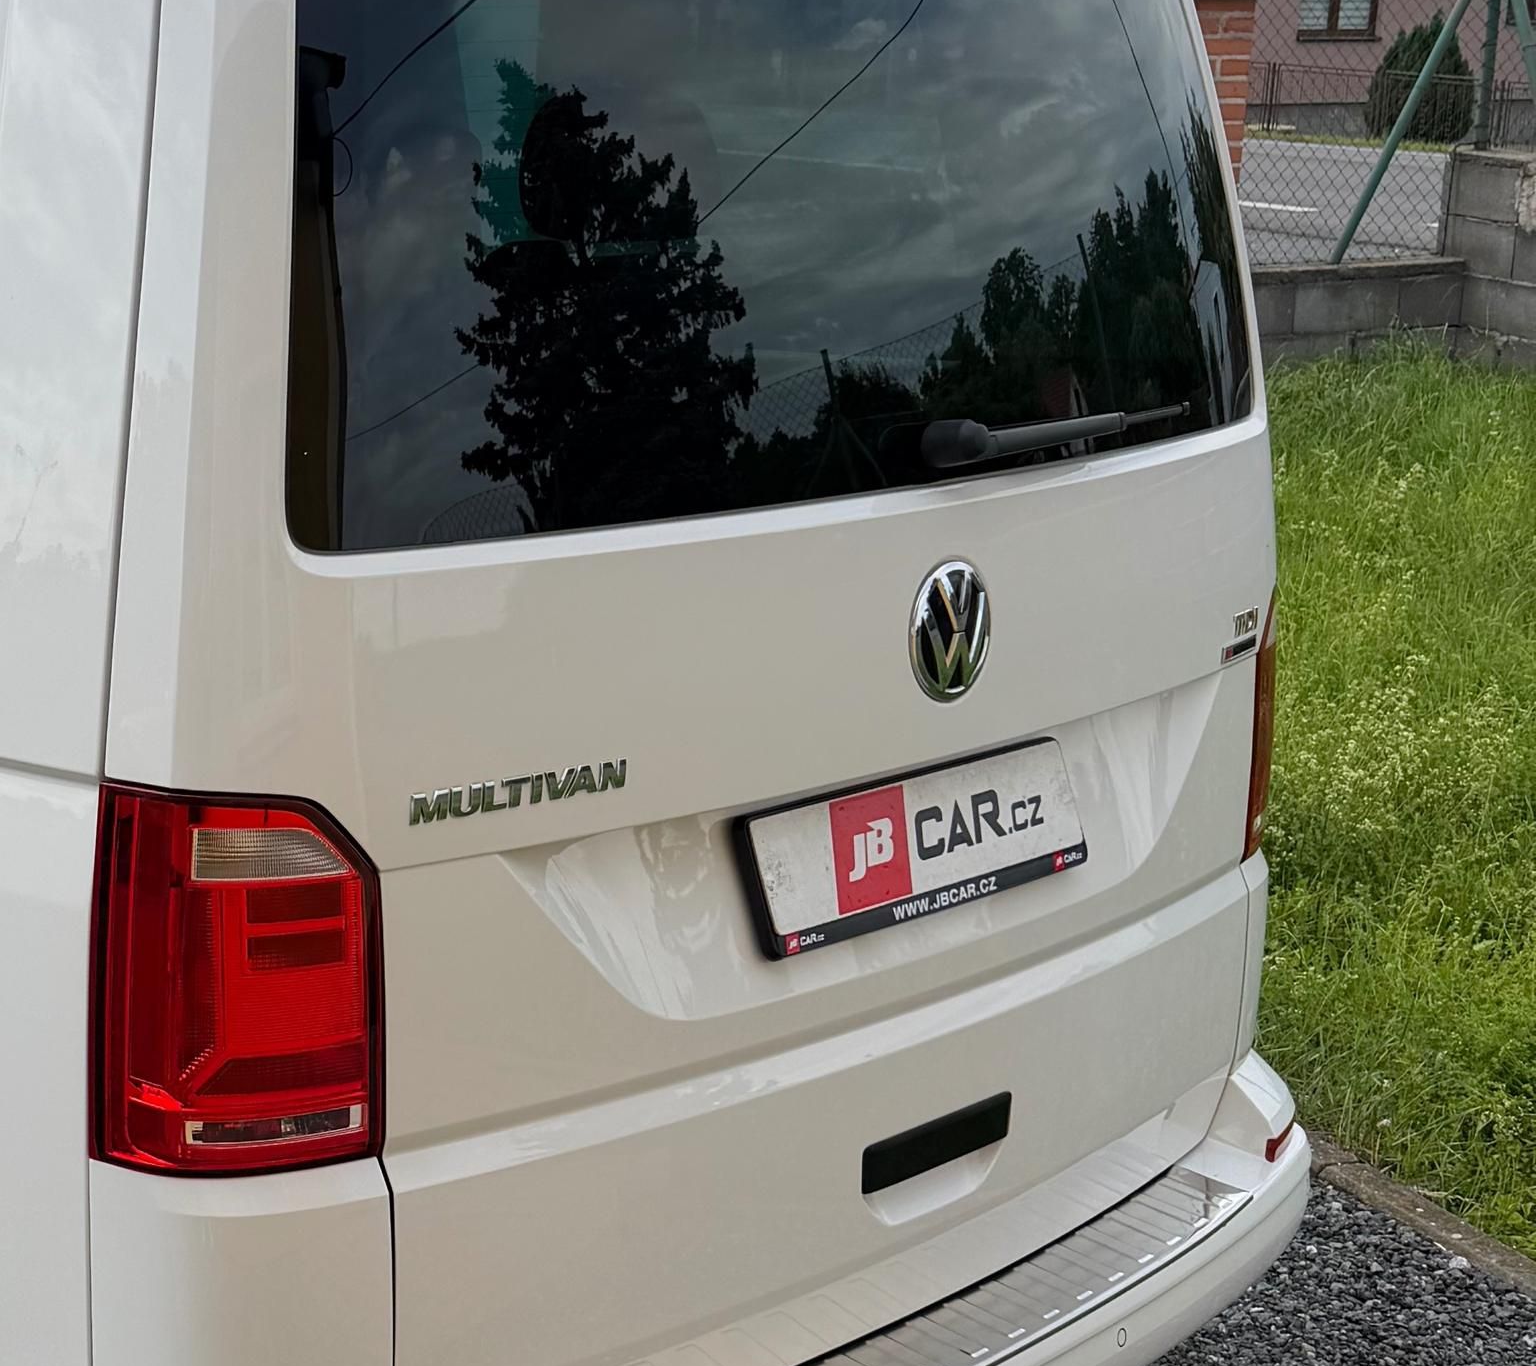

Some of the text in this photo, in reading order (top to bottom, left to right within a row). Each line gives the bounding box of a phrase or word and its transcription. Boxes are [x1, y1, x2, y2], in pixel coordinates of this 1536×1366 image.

[408, 757, 627, 827] MULTIVAN
[848, 816, 895, 883] JB
[892, 876, 998, 922] WWW.JBCAR.CZ
